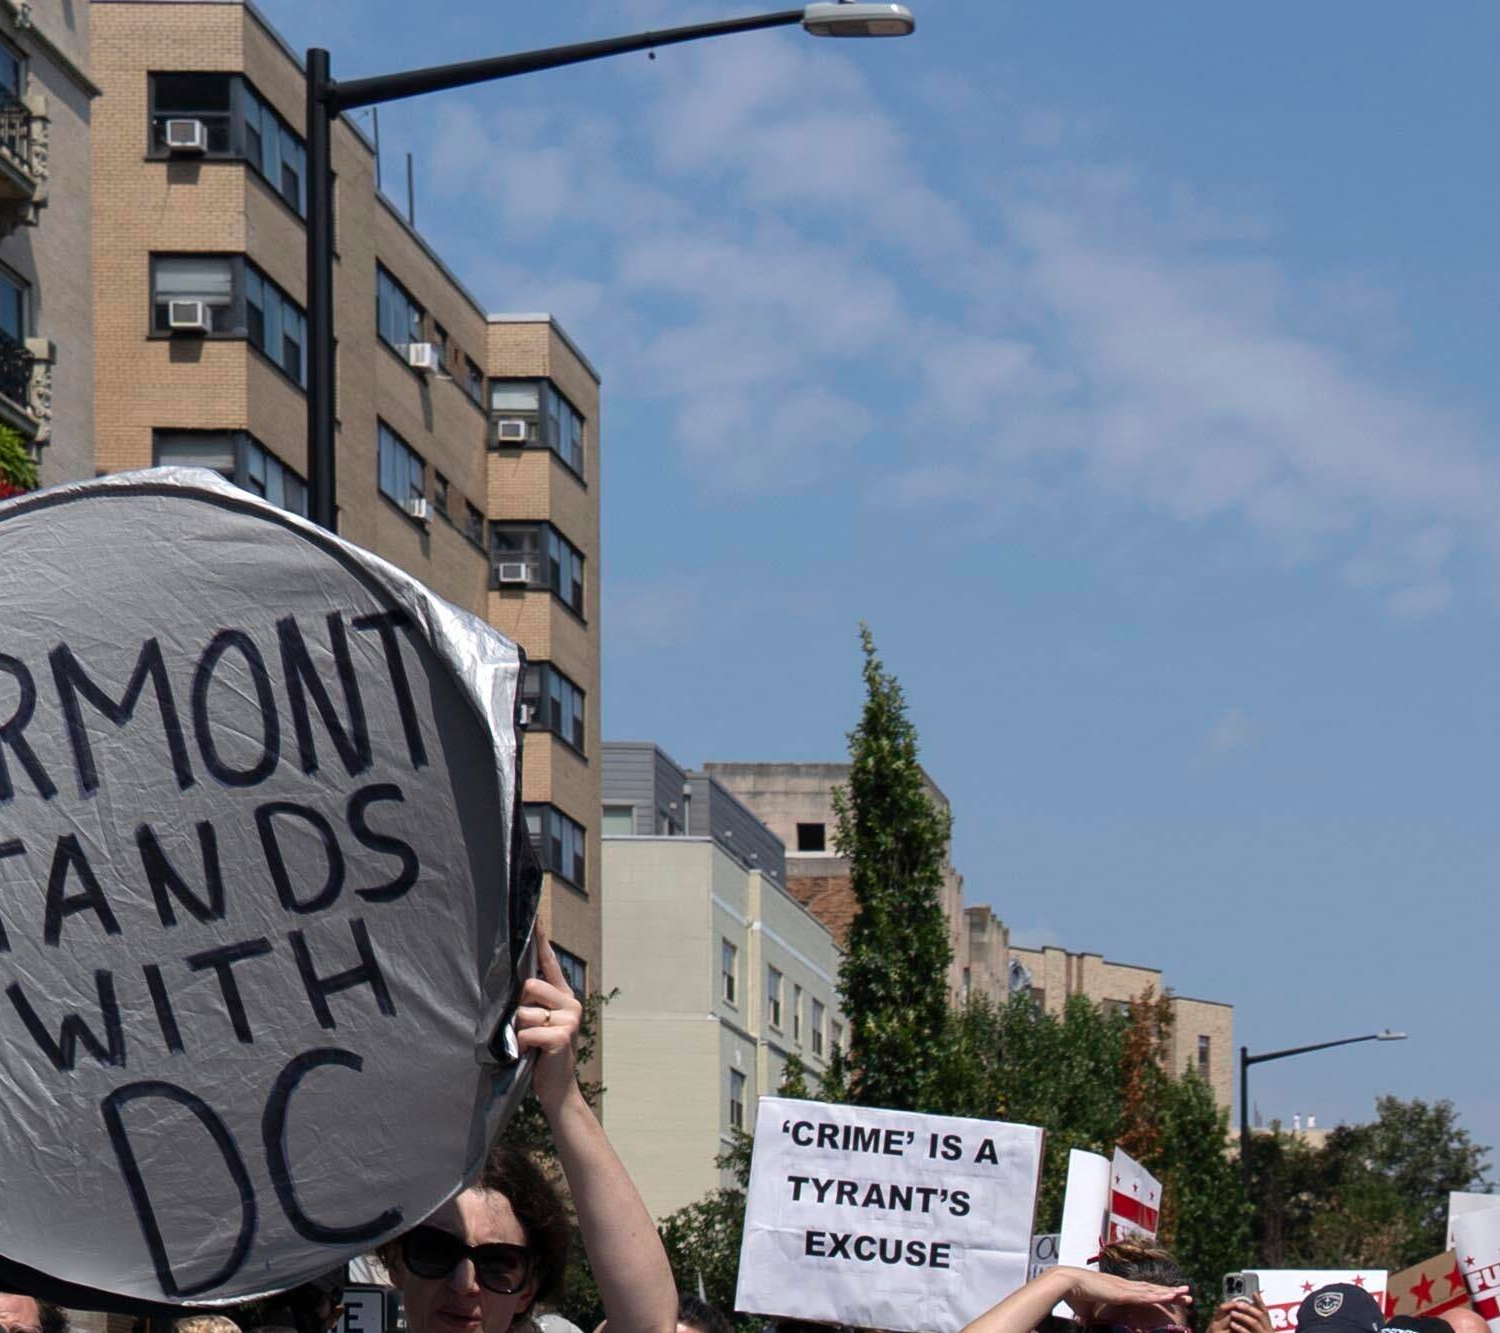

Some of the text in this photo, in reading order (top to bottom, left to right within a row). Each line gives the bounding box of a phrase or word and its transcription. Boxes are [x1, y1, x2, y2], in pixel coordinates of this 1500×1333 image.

[6, 918, 397, 1073] WITH
[929, 1133, 962, 1161] IS
[974, 1138, 999, 1165] A
[101, 1049, 404, 1297] DC
[788, 1176, 970, 1216] TYRANT'S
[805, 1230, 951, 1269] EXCUSE
